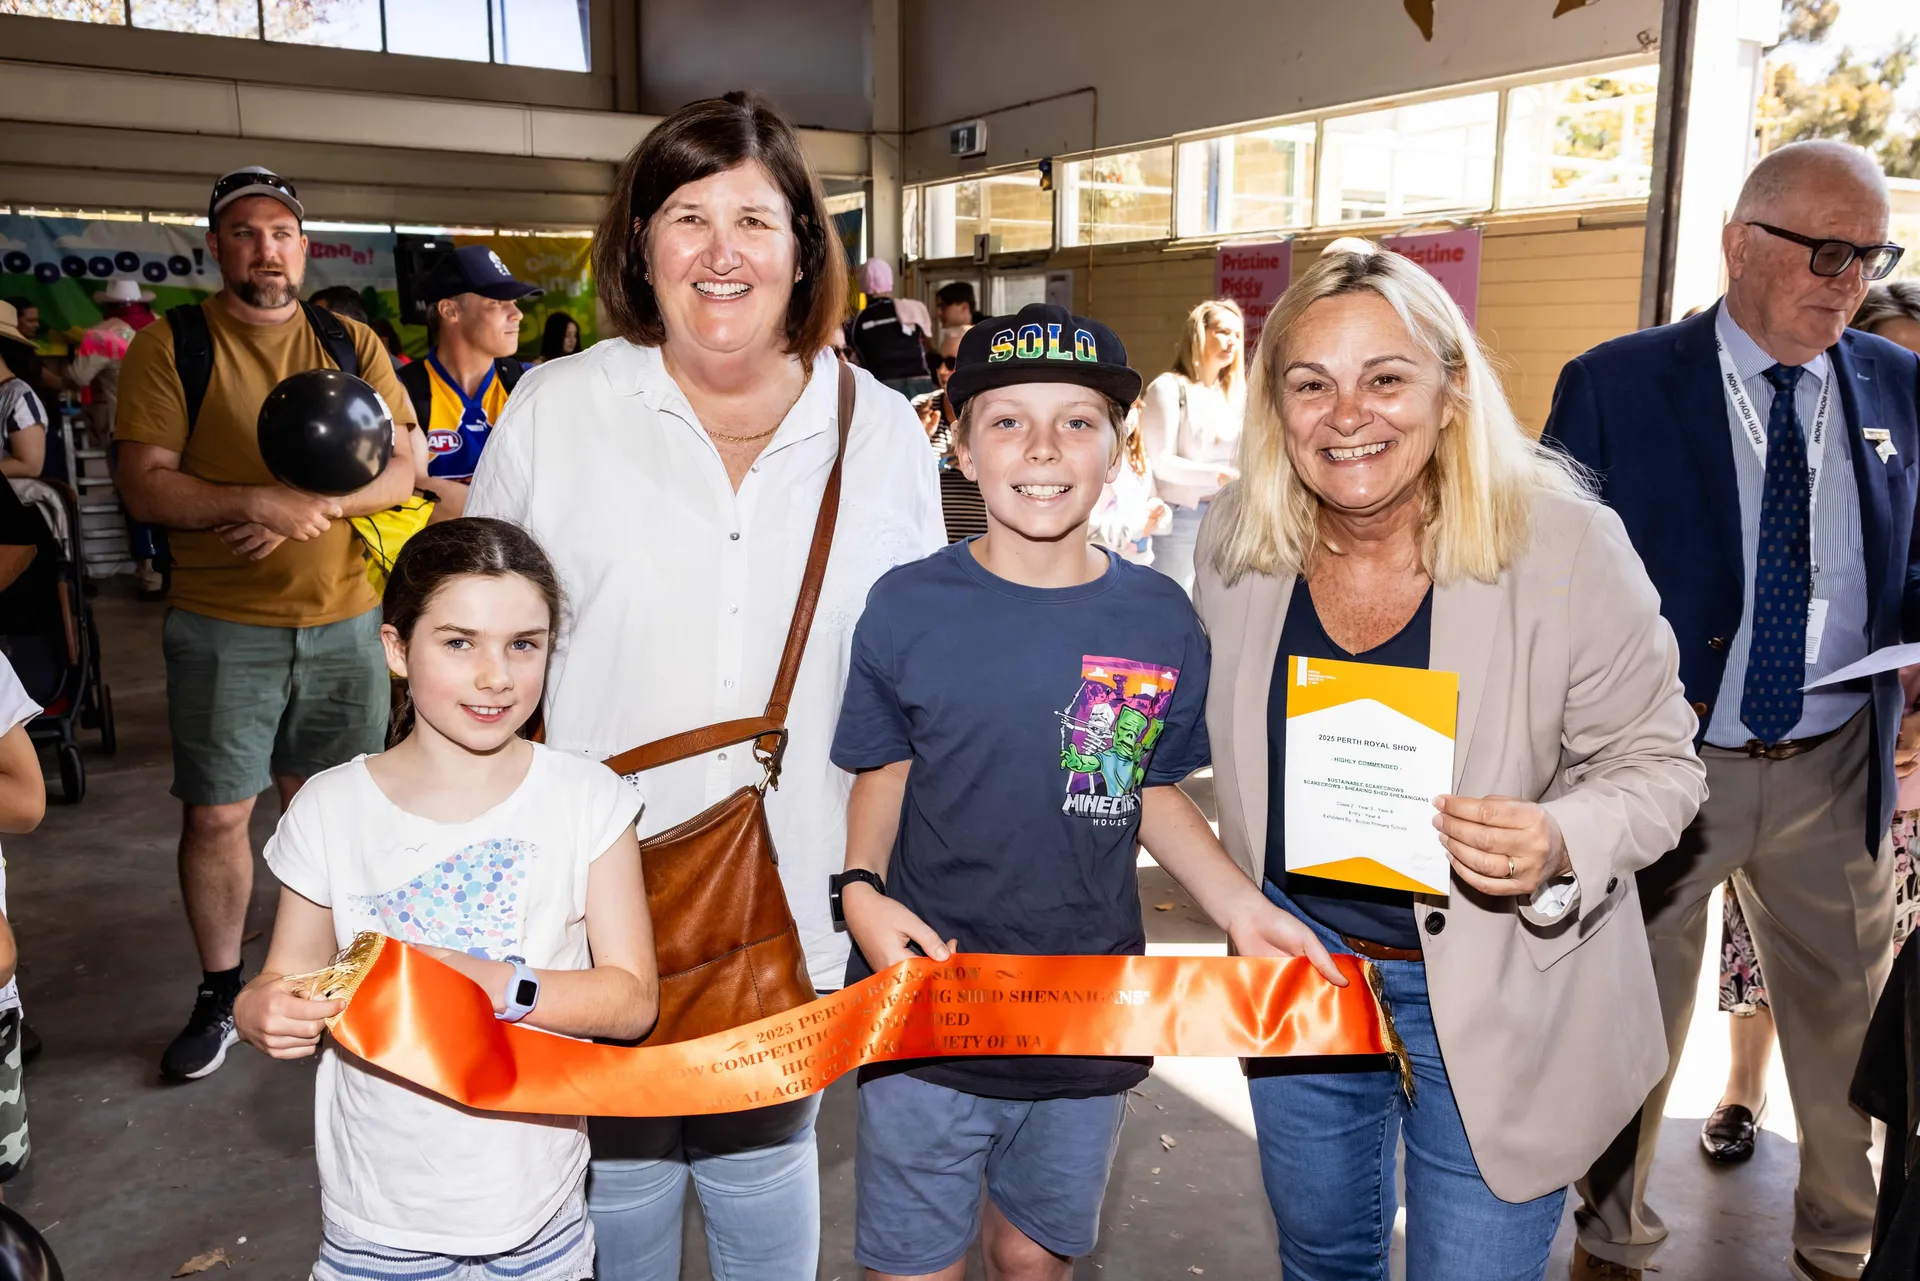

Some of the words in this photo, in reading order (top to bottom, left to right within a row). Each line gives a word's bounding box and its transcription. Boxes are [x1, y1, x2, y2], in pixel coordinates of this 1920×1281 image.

[975, 235, 986, 262] 1
[1222, 252, 1279, 271] Pristine
[1222, 277, 1263, 299] Piggy
[988, 323, 1098, 362] SOLO
[1725, 372, 1742, 396] SHOW
[1736, 395, 1752, 420] ROYAL
[1817, 395, 1829, 419] ROYAL
[428, 435, 459, 449] AFL
[1747, 419, 1764, 445] PERTH
[1813, 420, 1824, 445] SHOW
[1318, 734, 1335, 742] 2025
[1336, 736, 1361, 745] PERTH
[1364, 739, 1390, 749] ROYAL
[1392, 743, 1417, 752] SHOW
[1333, 756, 1356, 764] HIGHLY
[1357, 760, 1398, 770] COMMENDED
[1303, 779, 1340, 789] SCARECROWS
[1345, 785, 1372, 794] SHEARING
[1389, 792, 1429, 802] SHENANIGANS
[1327, 777, 1363, 787] SUSTAINABLE
[1365, 783, 1404, 793] SCARECROWS
[756, 1021, 794, 1044] 2025
[932, 966, 982, 981] SHOW
[957, 989, 1004, 1004] SHED
[987, 1034, 1009, 1049] OF
[1016, 1034, 1042, 1049] WA
